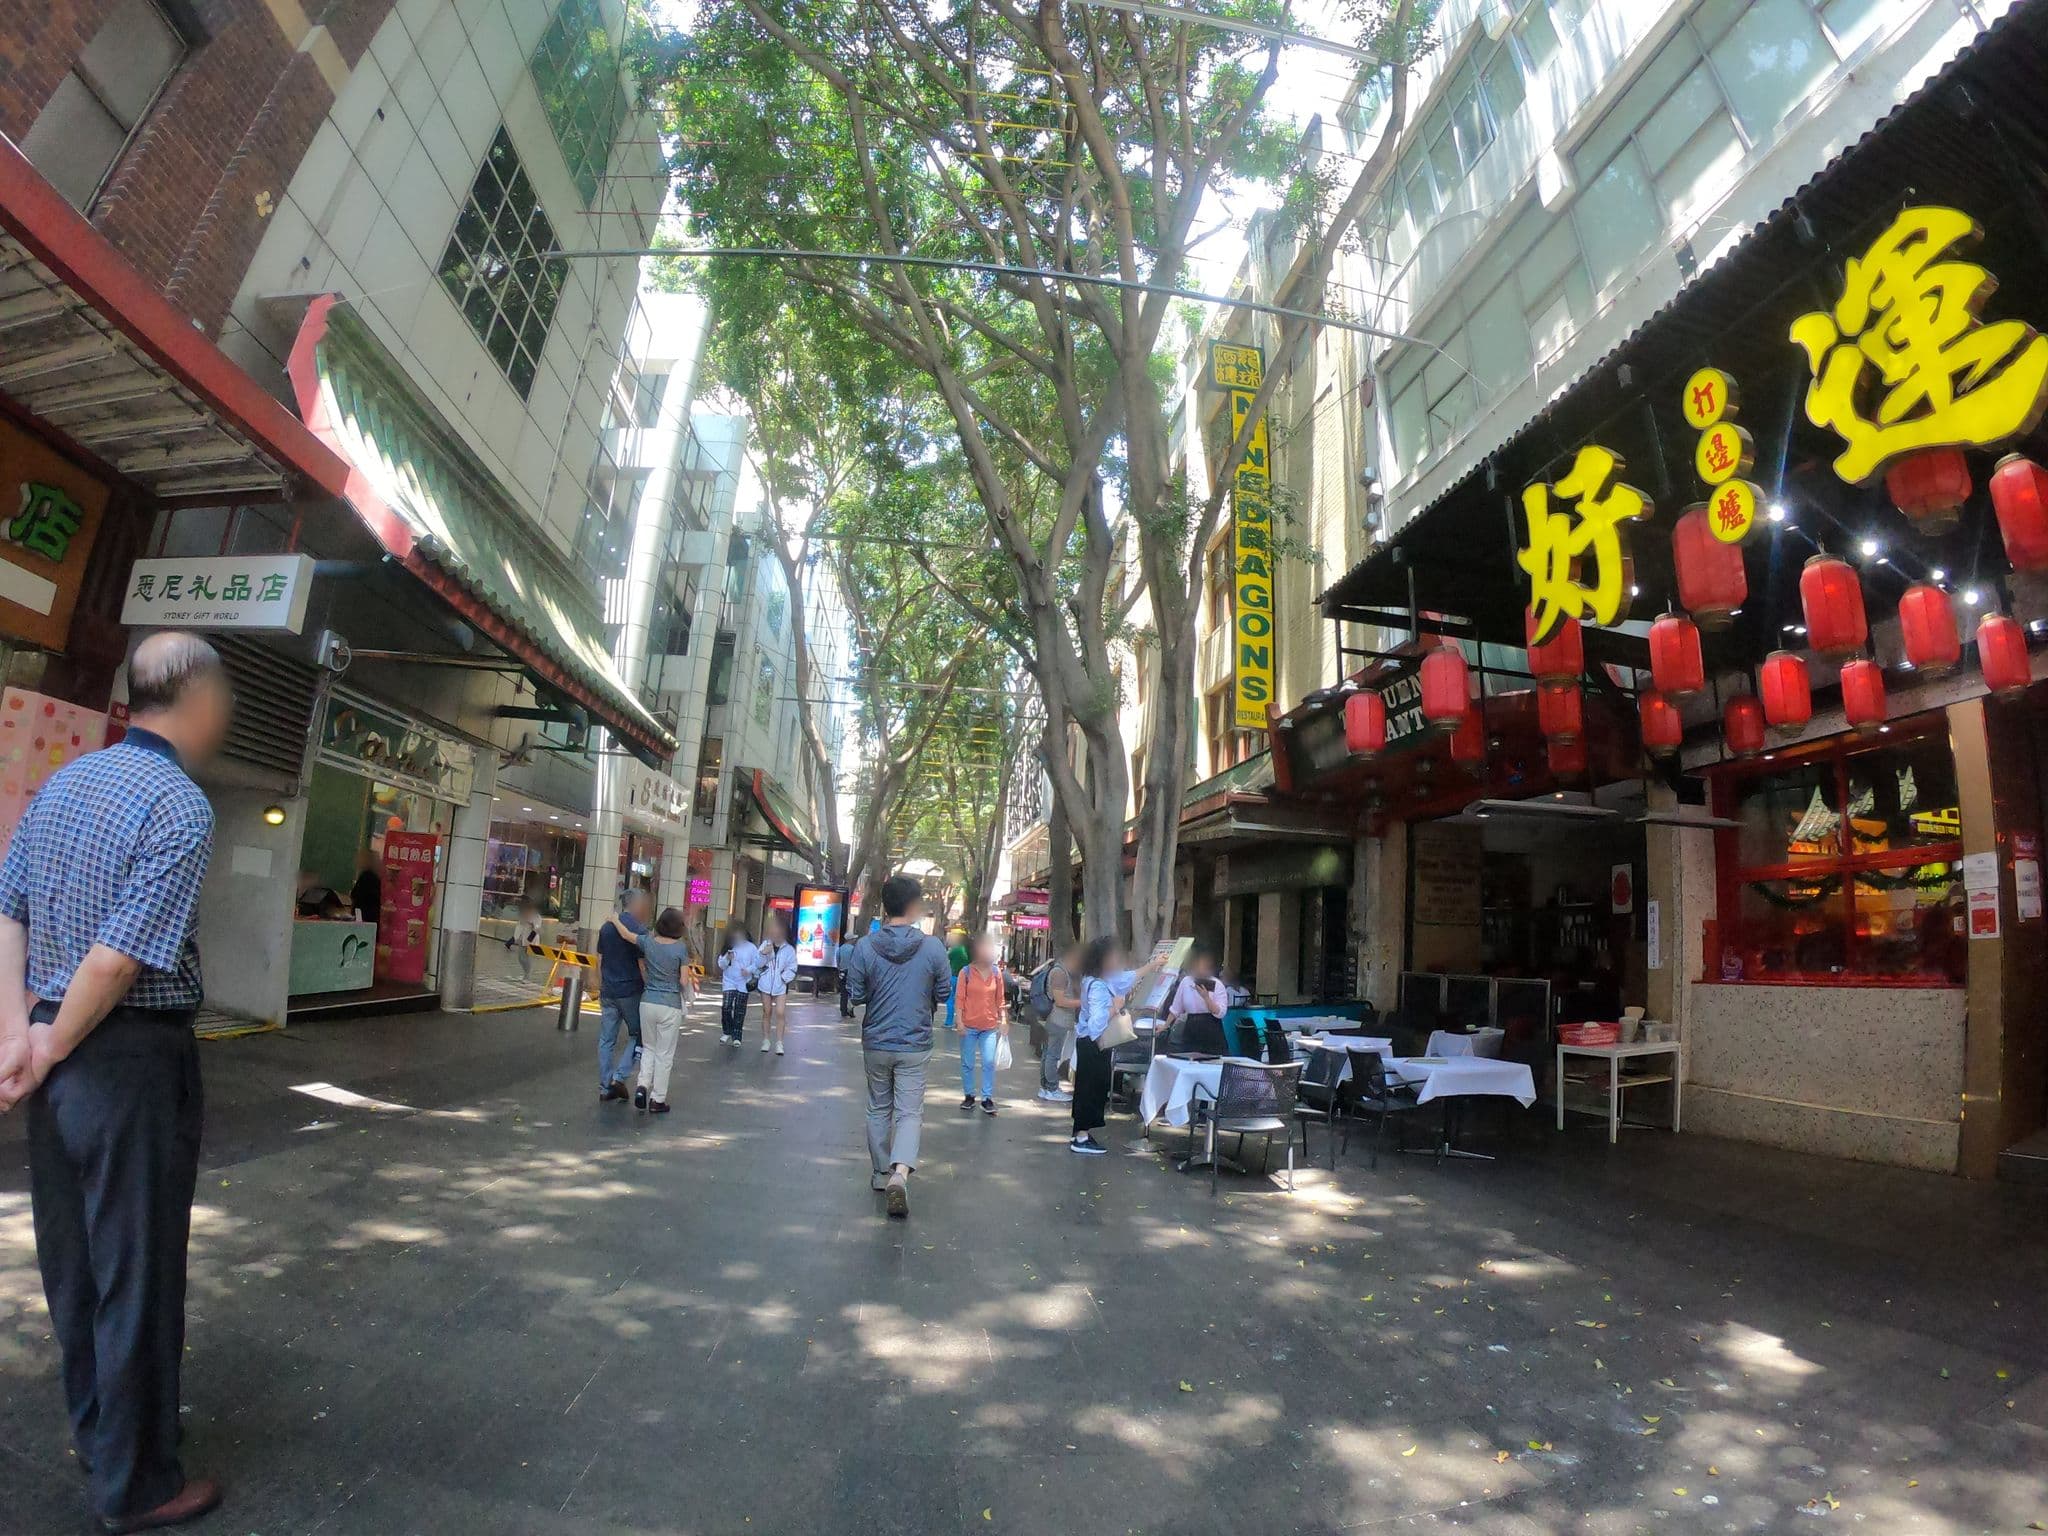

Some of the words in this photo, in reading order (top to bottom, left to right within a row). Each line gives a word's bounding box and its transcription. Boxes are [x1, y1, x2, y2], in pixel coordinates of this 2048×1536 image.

[163, 611, 190, 620] SYDNEY
[193, 611, 210, 620] GIFT
[213, 611, 240, 620] WORLD
[1238, 500, 1271, 701] DRAGONS
[1518, 445, 1646, 646] 好
